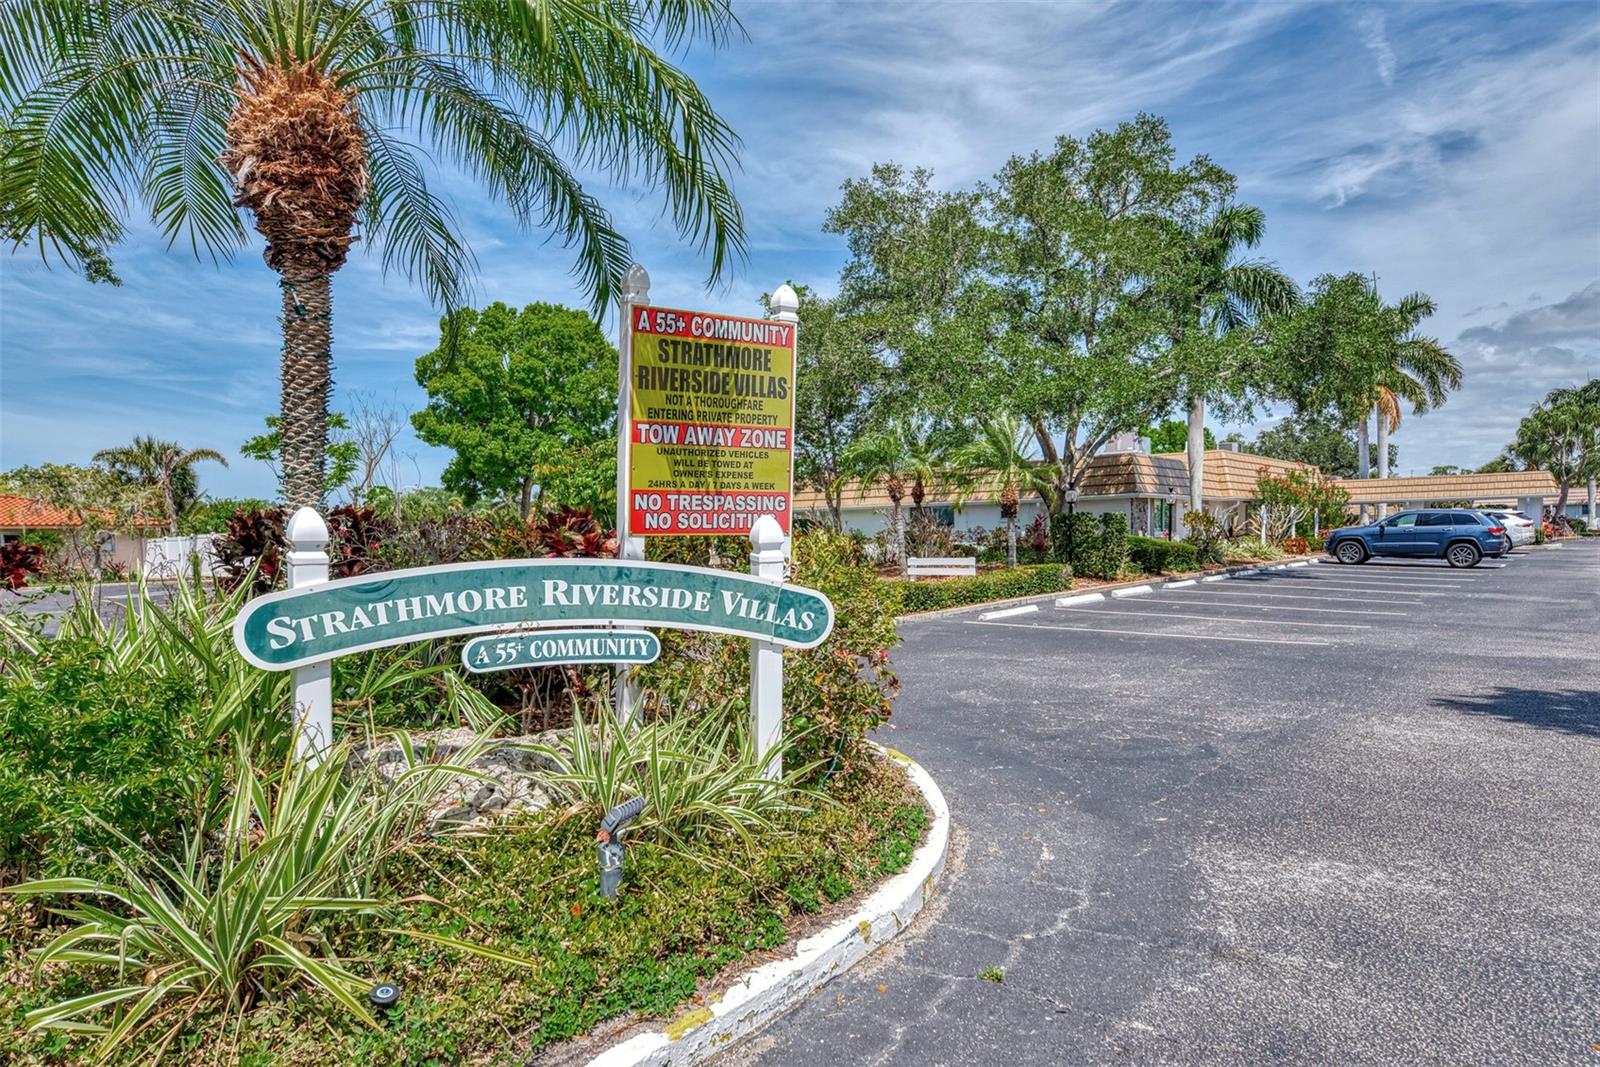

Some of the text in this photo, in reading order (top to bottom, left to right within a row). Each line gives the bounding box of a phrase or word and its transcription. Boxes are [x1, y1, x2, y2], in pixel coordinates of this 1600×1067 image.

[638, 310, 789, 346] A 55+ COMMUNITY
[658, 338, 772, 372] STRATHMORE
[638, 366, 787, 400] RIVERSIDE VILLAS
[665, 394, 763, 411] NOT A THOROUGHFARE
[648, 407, 778, 426] ENTERING PRIVATE PROPERTY
[637, 423, 786, 449] TOW AWAY ZONE
[657, 448, 769, 459] UNAUTHORIZED VEHICLES
[673, 459, 754, 469] WILL BE TOWED AT
[673, 470, 754, 479] OWNER'S EXPENSE
[648, 480, 677, 489] 24HRS
[680, 480, 686, 489] A
[688, 481, 705, 489] DAY
[712, 481, 717, 489] 7
[720, 481, 741, 490] DAYS
[744, 481, 750, 490] A
[752, 482, 776, 490] WEEK
[634, 494, 786, 512] NO TRESPASSING
[644, 513, 672, 529] NO
[266, 579, 816, 650] STRATHMORE RIVERSIDE VILLAS
[474, 638, 651, 665] A 55+ COMMUNITY
